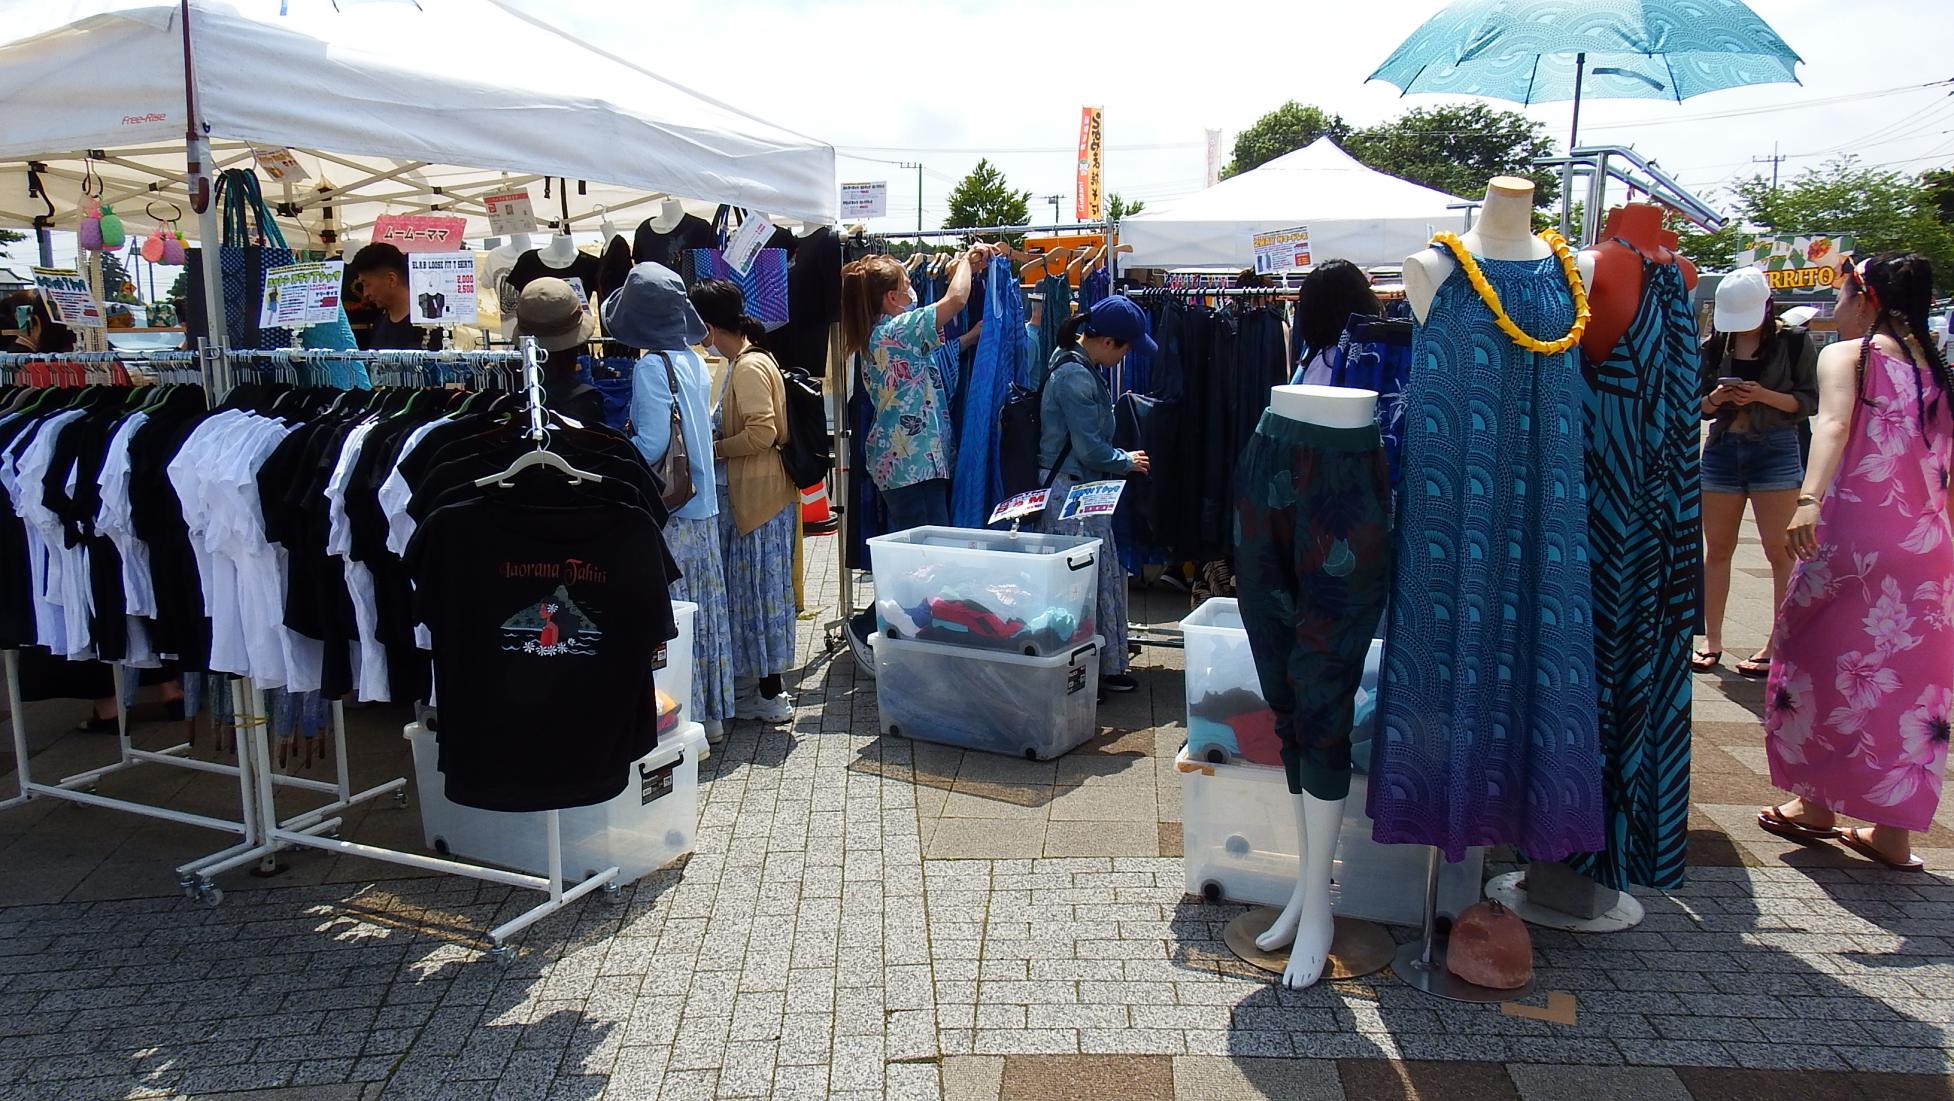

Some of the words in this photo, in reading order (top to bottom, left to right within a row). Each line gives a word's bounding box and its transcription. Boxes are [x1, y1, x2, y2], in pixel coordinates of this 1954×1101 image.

[121, 113, 166, 125] Free-Rise
[384, 226, 449, 241] ムームーママ
[457, 275, 474, 284] 2,000
[1763, 266, 1834, 289] RRITO
[457, 285, 474, 294] 2,500
